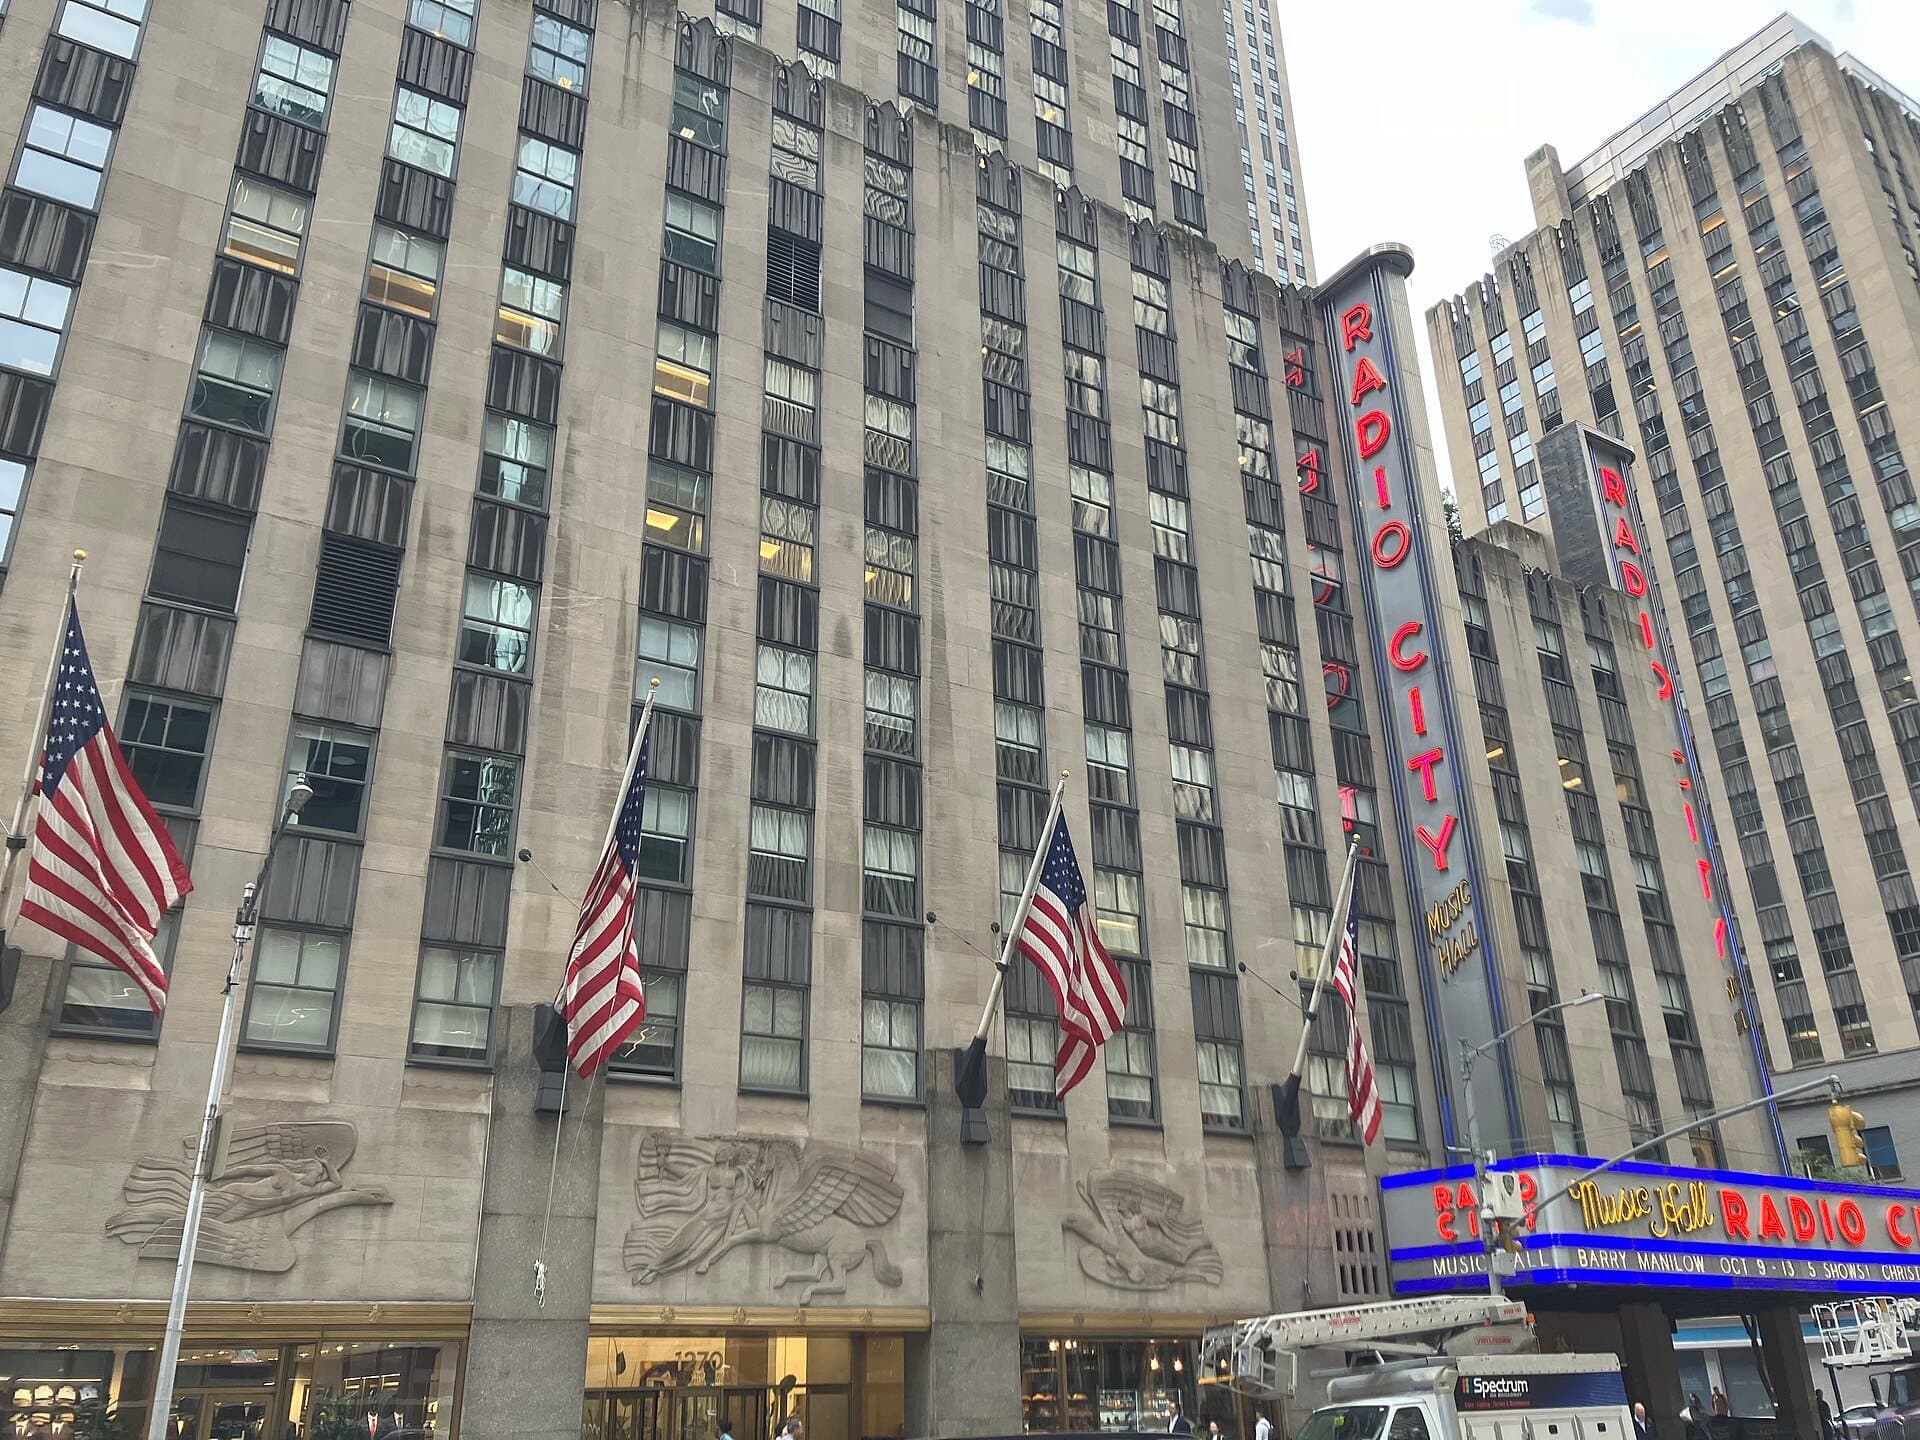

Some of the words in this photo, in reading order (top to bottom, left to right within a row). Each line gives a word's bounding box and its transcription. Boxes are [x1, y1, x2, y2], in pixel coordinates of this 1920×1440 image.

[1340, 302, 1411, 568] RADIO
[1389, 621, 1457, 871] CITY
[1568, 1178, 1652, 1230] Music
[1651, 1181, 1714, 1238] Hall
[1719, 1188, 1868, 1247] RADIO
[1432, 1254, 1488, 1276] MUSIC
[1513, 1249, 1550, 1270] ALL
[1577, 1248, 1627, 1270] BARRY
[1637, 1251, 1705, 1273] MANILOW
[1720, 1257, 1748, 1276] OCT
[1808, 1261, 1817, 1278] 5
[675, 1351, 724, 1371] 1270
[1473, 1377, 1529, 1399] Spectrum
